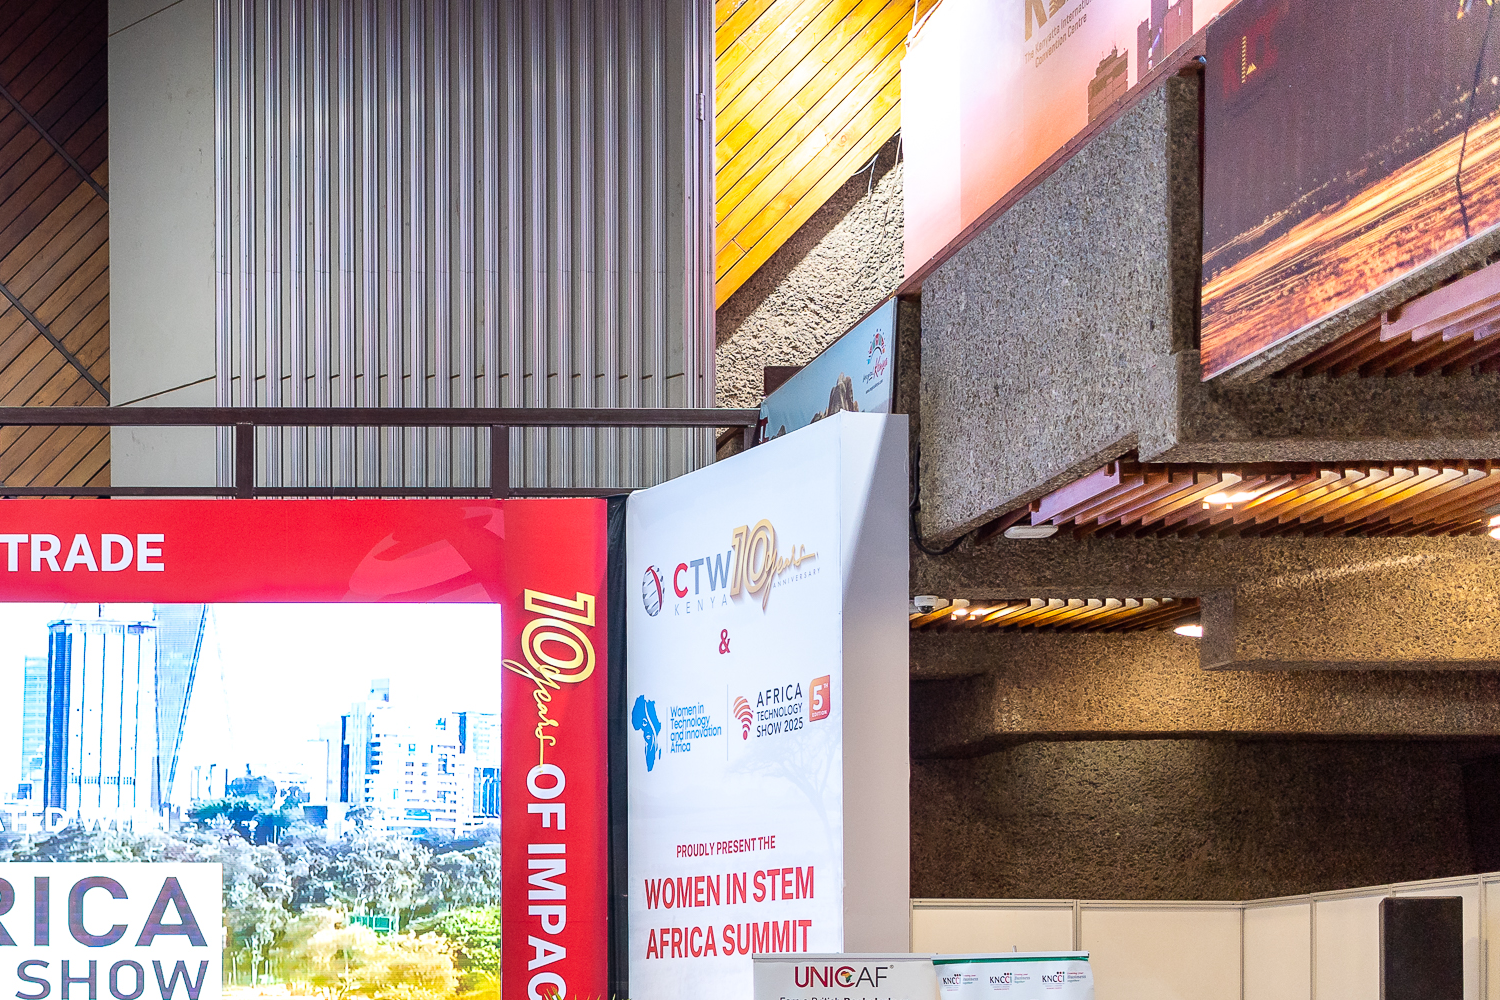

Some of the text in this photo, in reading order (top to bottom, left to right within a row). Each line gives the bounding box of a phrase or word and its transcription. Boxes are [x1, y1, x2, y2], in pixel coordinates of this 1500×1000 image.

[1068, 14, 1087, 37] Centre
[673, 550, 732, 598] CTW
[730, 518, 775, 597] 10
[674, 566, 821, 616] KENYA ANNIVERSARY
[521, 588, 596, 683] 10
[719, 629, 730, 654] &
[756, 683, 803, 707] AFRICA
[670, 702, 704, 717] Women in
[757, 703, 803, 721] TECHNOLOGY
[670, 724, 721, 741] and innovation
[671, 715, 710, 730] Technology
[756, 717, 803, 738] SHOW 2025
[670, 741, 691, 753] Africa
[526, 763, 566, 831] OF
[676, 835, 775, 858] PROUDLY PRESENT THE
[644, 866, 815, 910] WOMEN IN STEM
[646, 920, 812, 959] AFRICA SUMMIT
[15, 959, 209, 1000] SHOW
[794, 966, 888, 988] UNICAF
